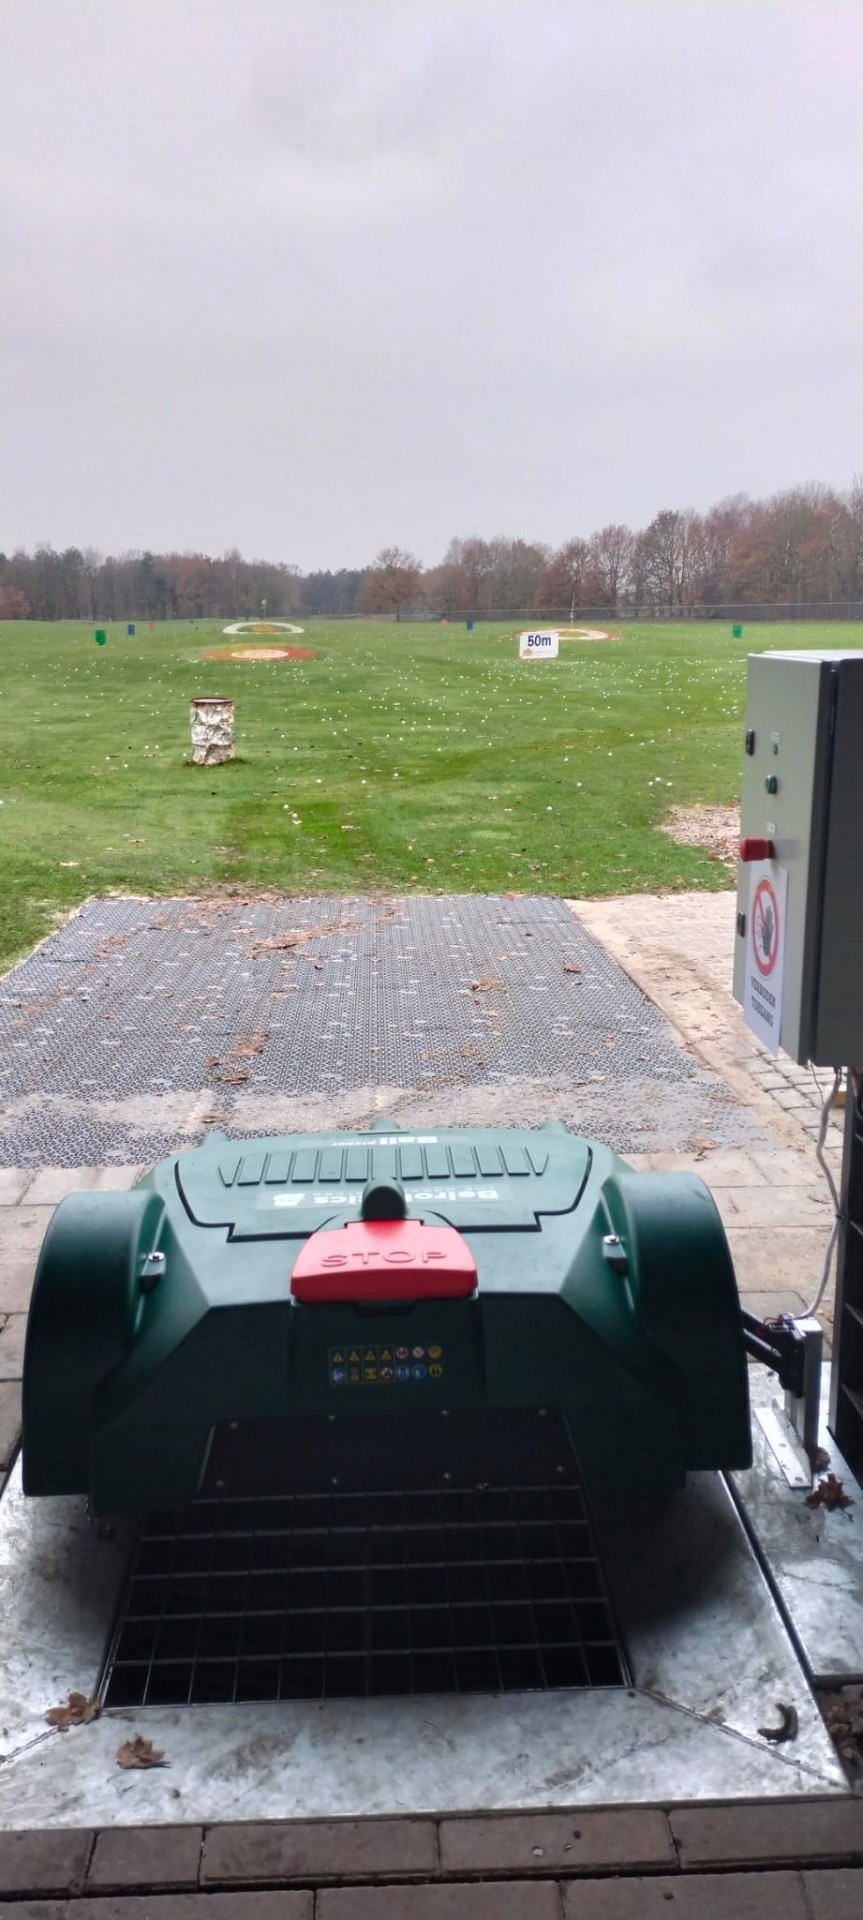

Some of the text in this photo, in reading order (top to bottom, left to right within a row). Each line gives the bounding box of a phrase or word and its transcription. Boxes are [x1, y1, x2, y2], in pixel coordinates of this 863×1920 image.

[527, 634, 552, 647] 50m
[750, 975, 776, 1008] VERBODEN
[320, 1250, 448, 1268] STOP
